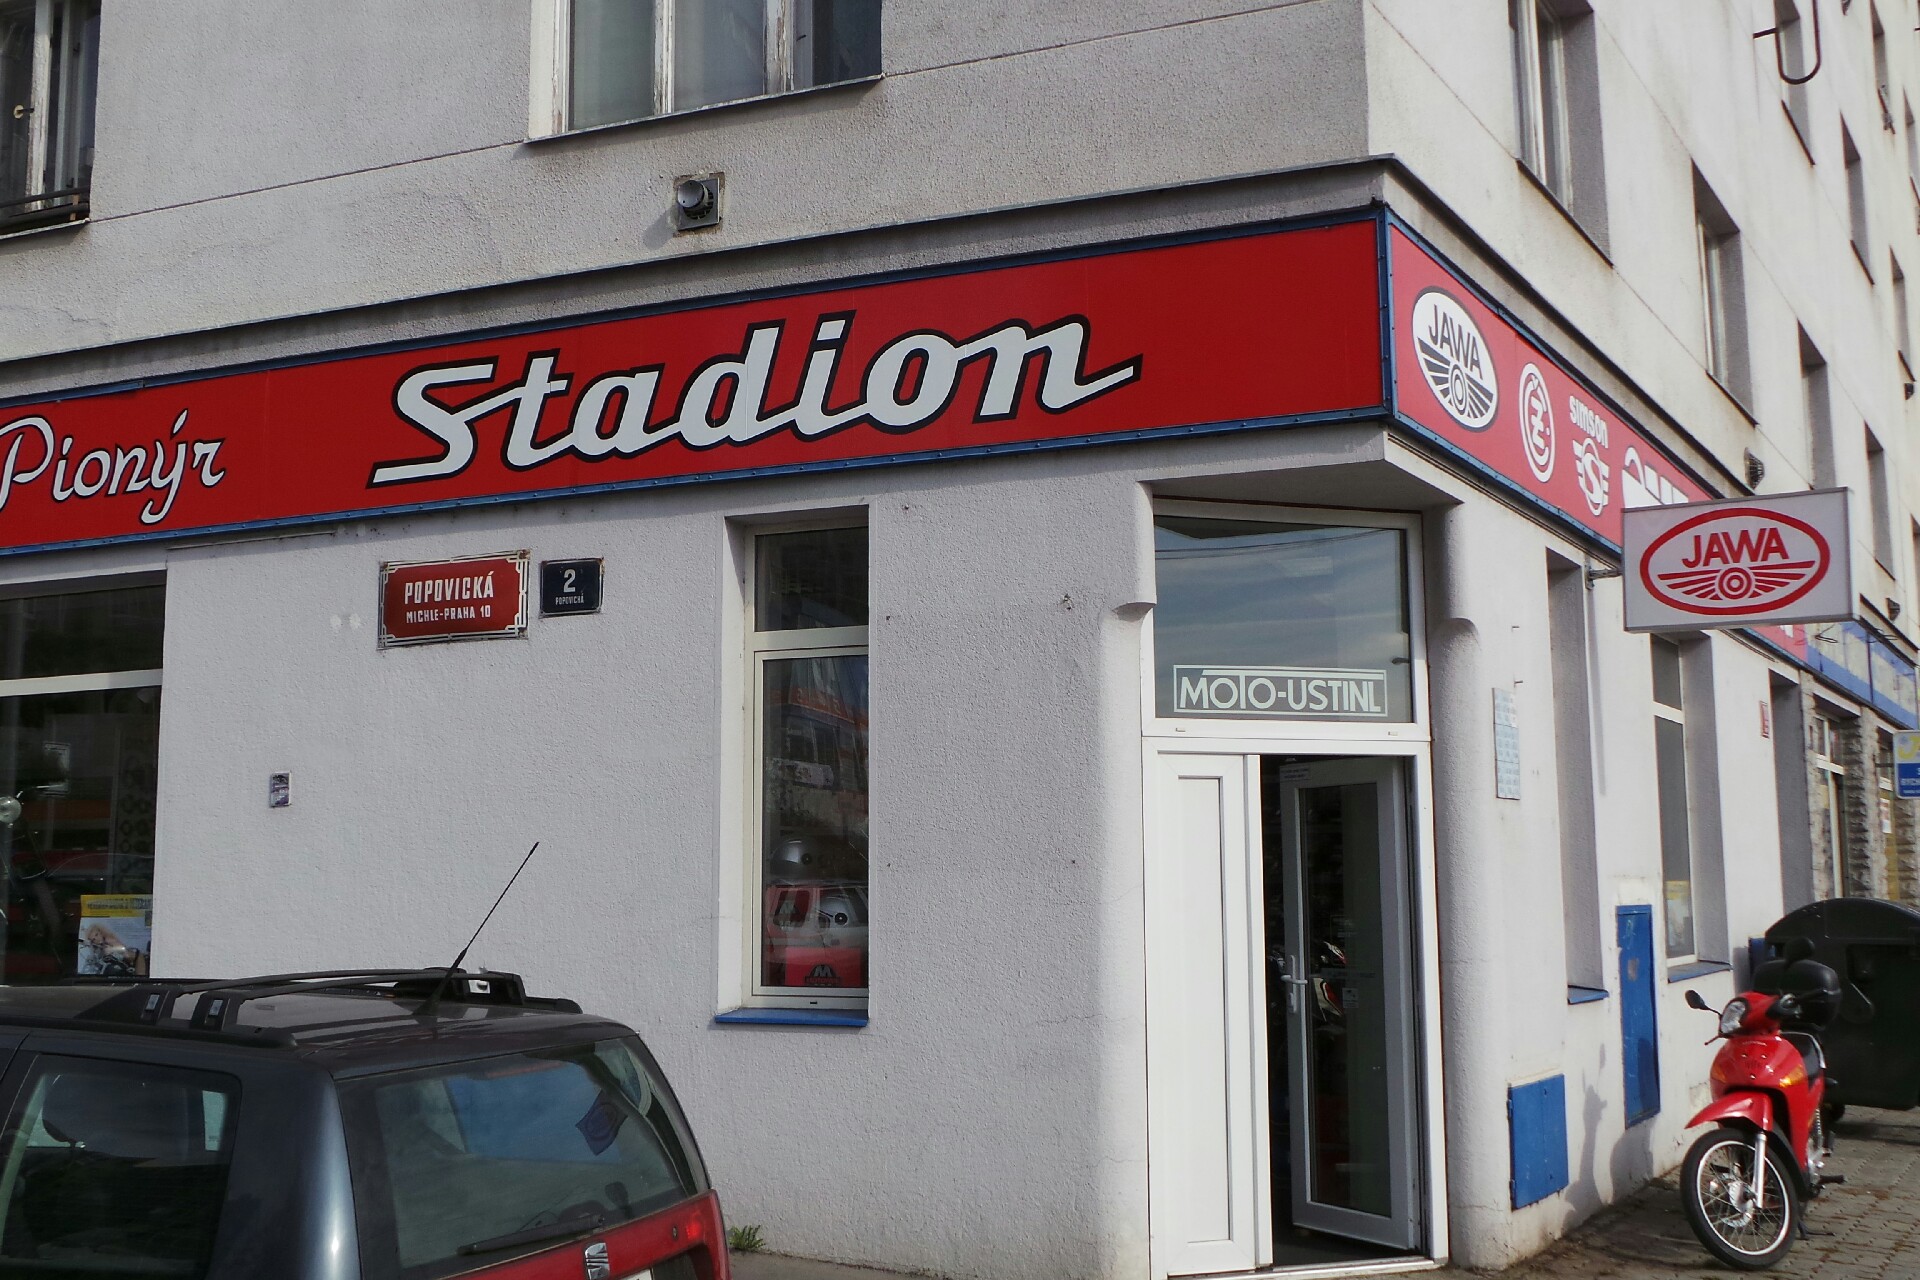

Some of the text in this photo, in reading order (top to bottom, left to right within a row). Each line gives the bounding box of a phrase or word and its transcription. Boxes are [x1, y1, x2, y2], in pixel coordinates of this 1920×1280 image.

[1428, 304, 1484, 381] JAWA
[367, 310, 1141, 488] Stadion
[0, 410, 225, 524] Pionýr
[1681, 527, 1790, 569] JAWA
[404, 571, 494, 605] POPOVICKÁ
[563, 568, 576, 593] 2
[406, 604, 491, 624] MICHLE-PRAHA 10
